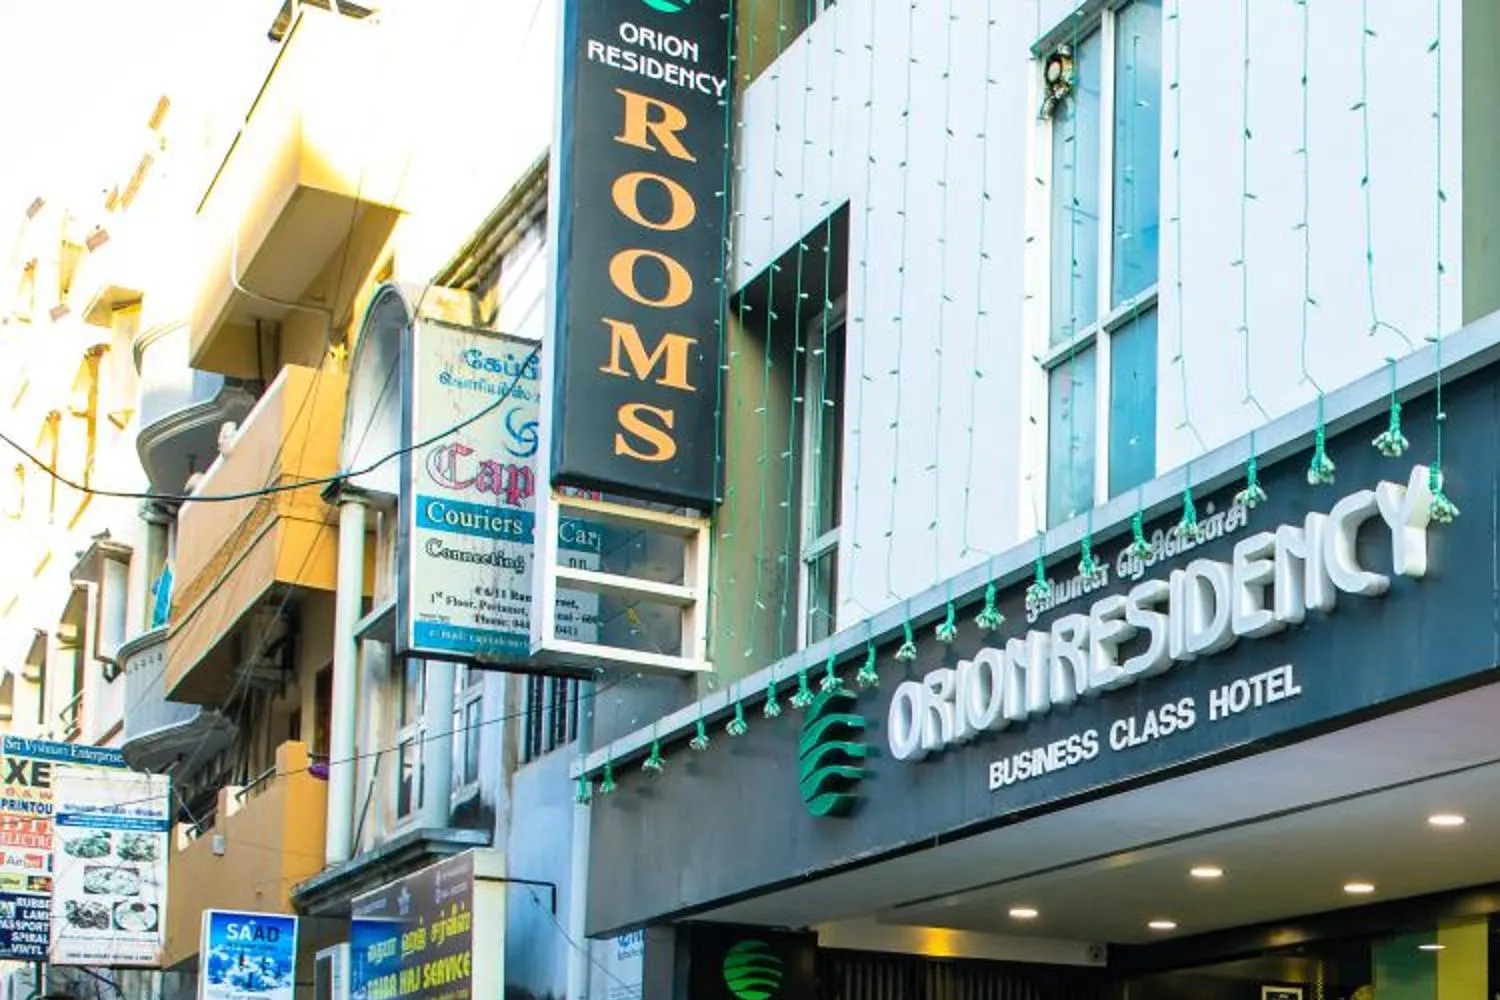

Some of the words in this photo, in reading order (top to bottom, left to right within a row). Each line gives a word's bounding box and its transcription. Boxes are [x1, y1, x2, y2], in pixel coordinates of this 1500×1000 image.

[587, 39, 727, 97] RESIDENCY
[618, 20, 699, 63] ORION
[599, 87, 698, 463] ROOMS
[426, 502, 524, 535] Couriers
[559, 521, 600, 549] Car
[888, 630, 1052, 761] ORION
[1050, 464, 1444, 705] RESIDENCY
[988, 727, 1100, 792] BUSINESS
[1109, 698, 1197, 752] CLASS
[1208, 664, 1303, 723] HOTEL
[226, 923, 281, 943] SAAD
